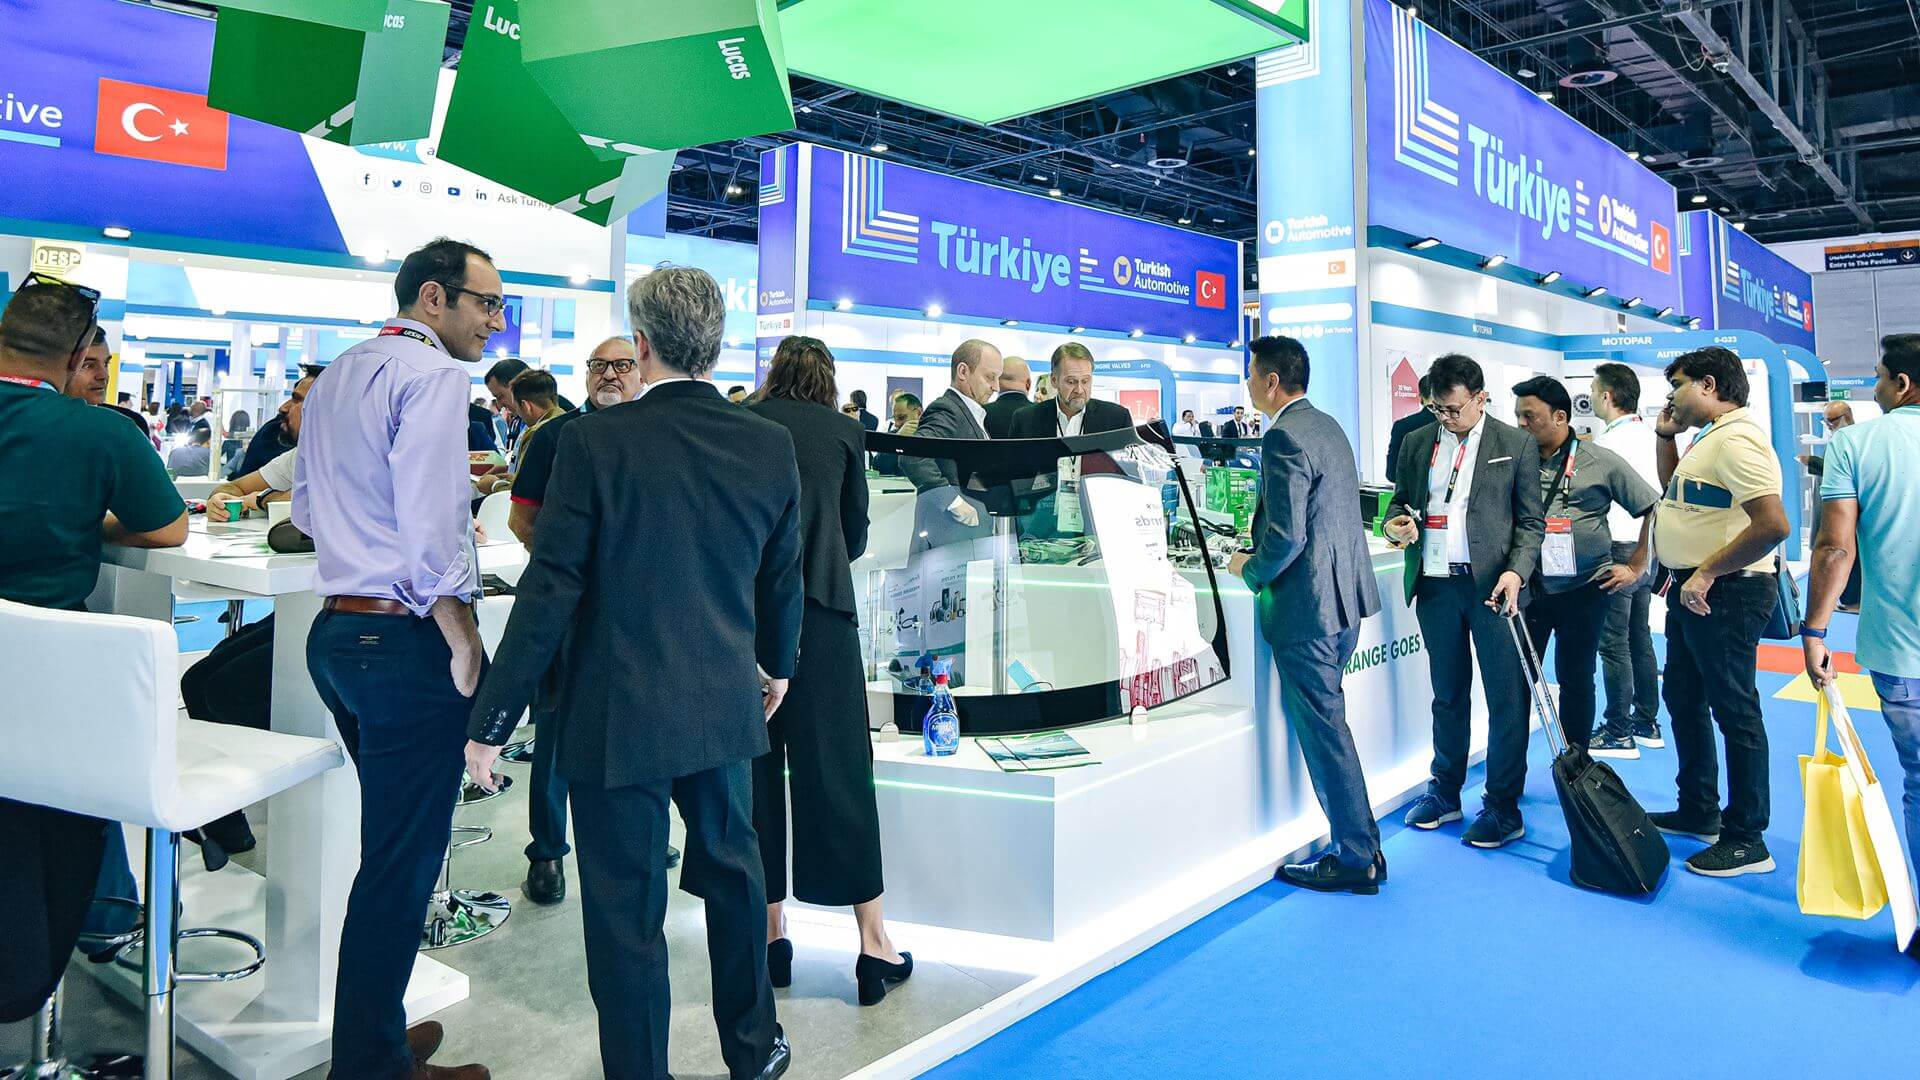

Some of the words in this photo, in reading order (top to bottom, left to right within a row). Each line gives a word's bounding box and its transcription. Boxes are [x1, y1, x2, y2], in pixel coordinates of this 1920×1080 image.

[717, 37, 751, 80] Lucas
[0, 92, 63, 128] ive
[1467, 123, 1571, 241] Türkiye
[498, 193, 518, 204] Ask
[1287, 214, 1329, 229] Turkish
[1287, 225, 1352, 243] Automotive
[36, 248, 81, 266] OESP
[931, 220, 1071, 294] Türkiye
[1134, 258, 1172, 278] Turkish
[1133, 277, 1190, 296] Automotive
[1602, 337, 1652, 346] MOTOPAR
[1345, 643, 1387, 675] RANGE
[1390, 633, 1421, 660] GOES
